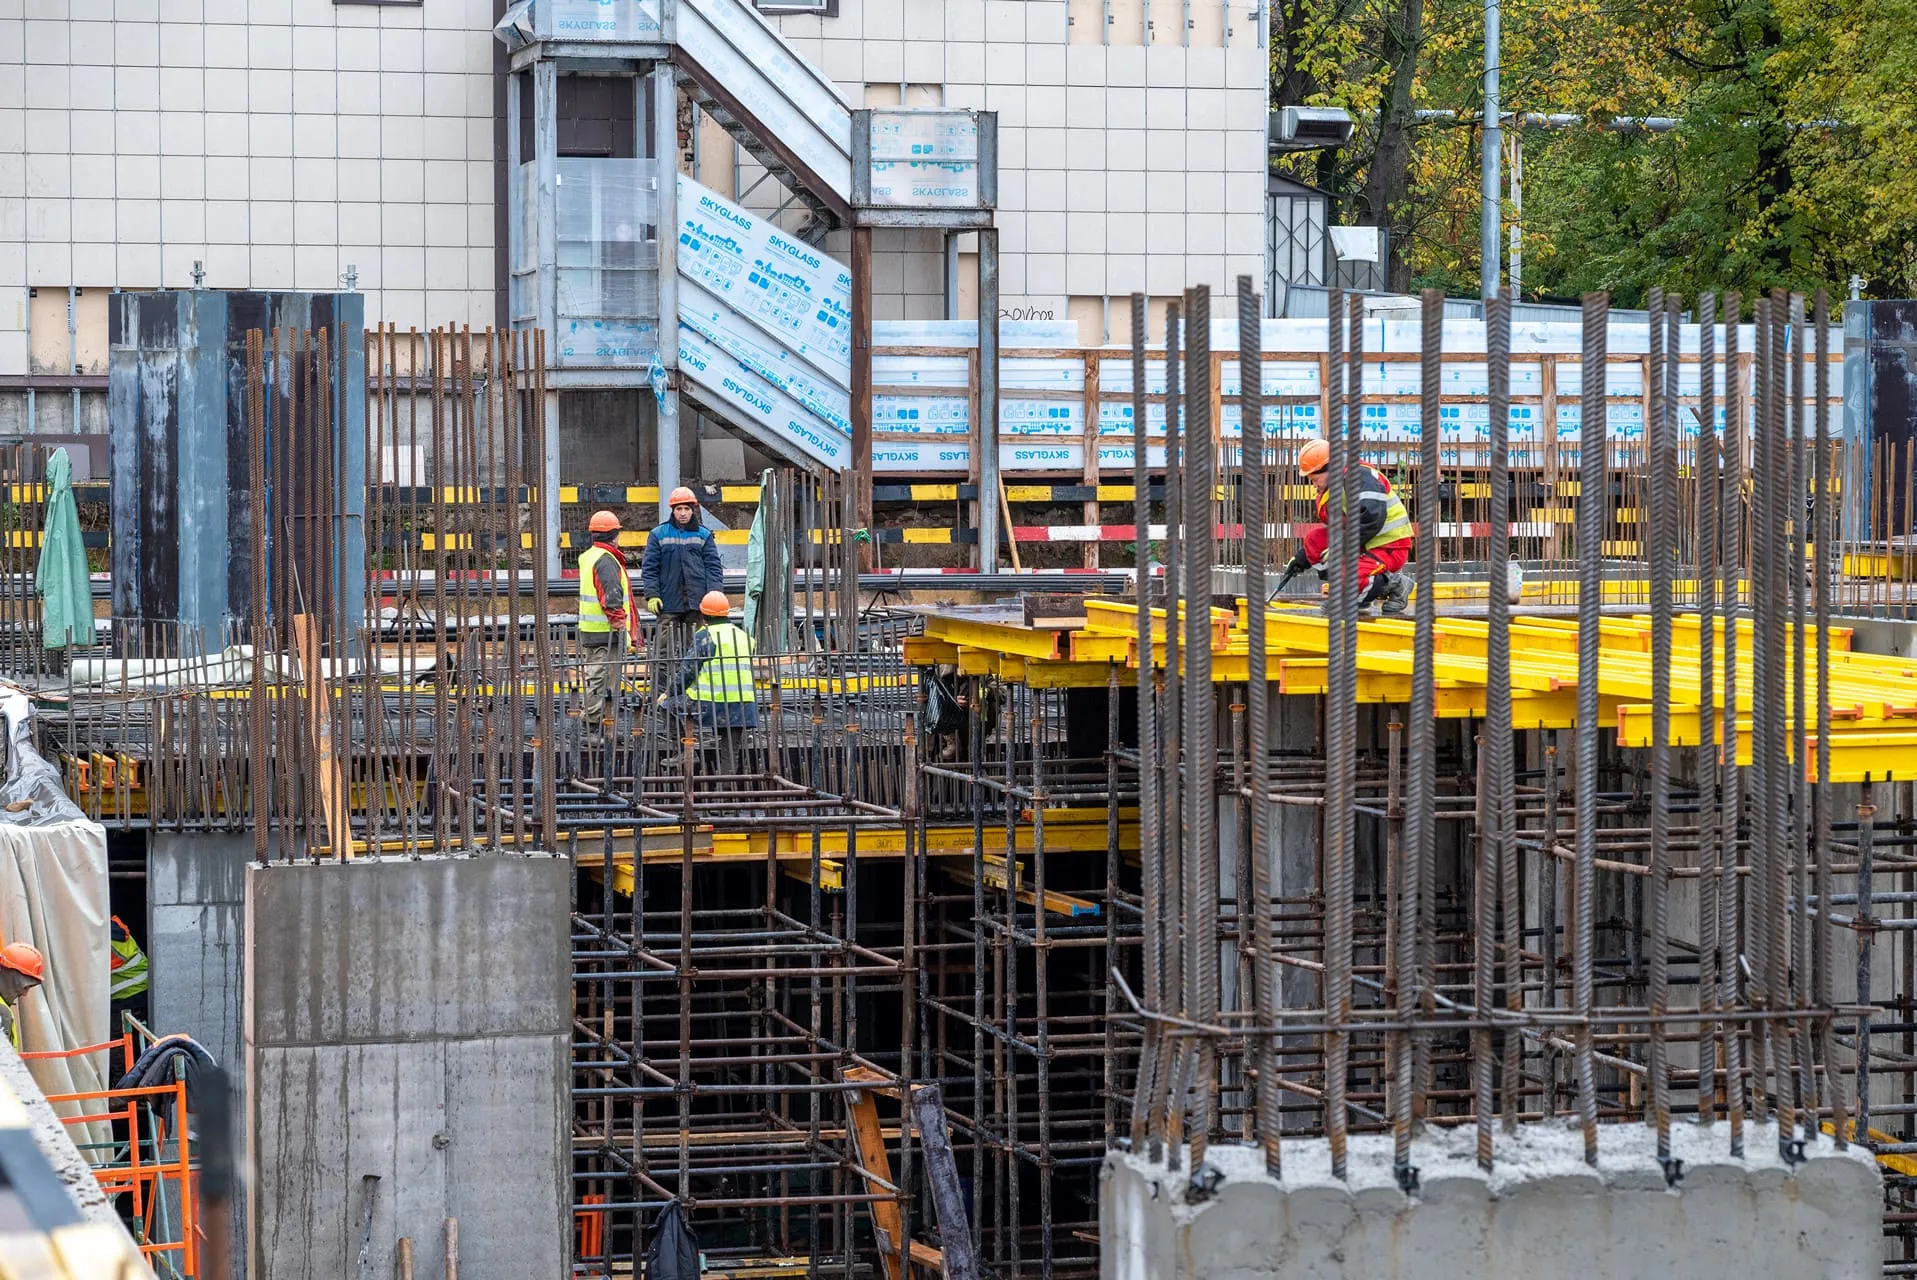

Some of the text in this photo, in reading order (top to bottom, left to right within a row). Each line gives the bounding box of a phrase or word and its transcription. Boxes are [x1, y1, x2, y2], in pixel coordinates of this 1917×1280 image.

[699, 196, 753, 231] SKYGLASS
[768, 235, 821, 269] SKYGLASS
[722, 377, 773, 415] SKYGLASS
[788, 420, 838, 457] SKYGLASS
[1015, 451, 1070, 460] SKYGLASS
[872, 452, 919, 461] SKYGLAS
